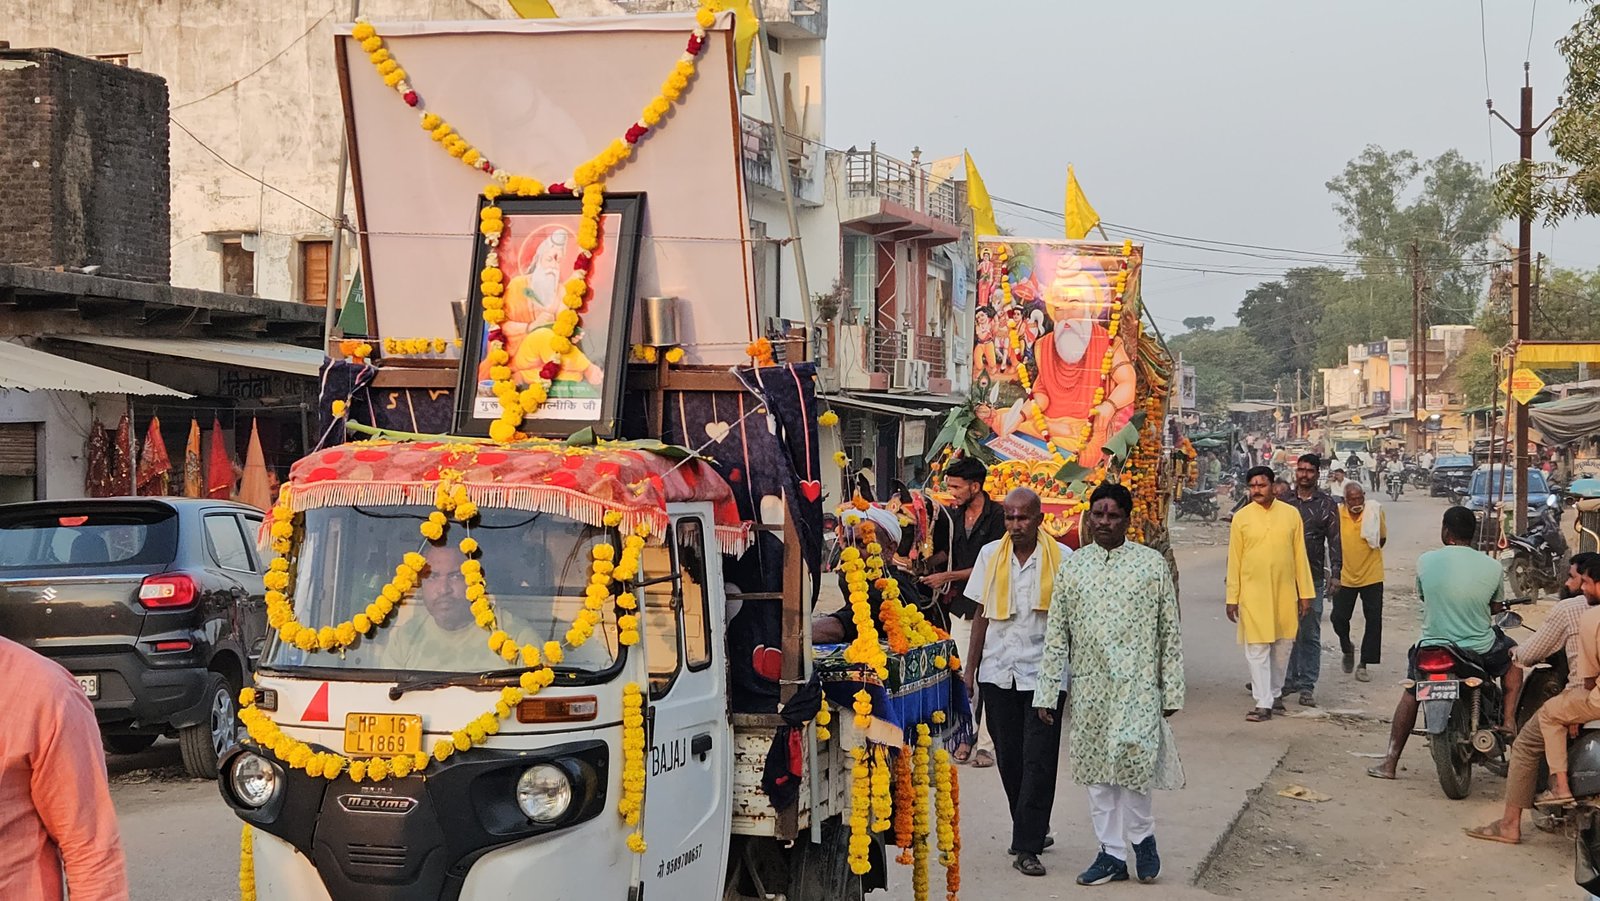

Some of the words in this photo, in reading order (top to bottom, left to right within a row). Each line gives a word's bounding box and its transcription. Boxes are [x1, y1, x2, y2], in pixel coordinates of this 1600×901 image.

[583, 400, 596, 411] जी
[359, 716, 376, 733] MP
[391, 717, 406, 734] 16
[357, 735, 406, 752] L1869
[652, 738, 686, 777] BAJAJ
